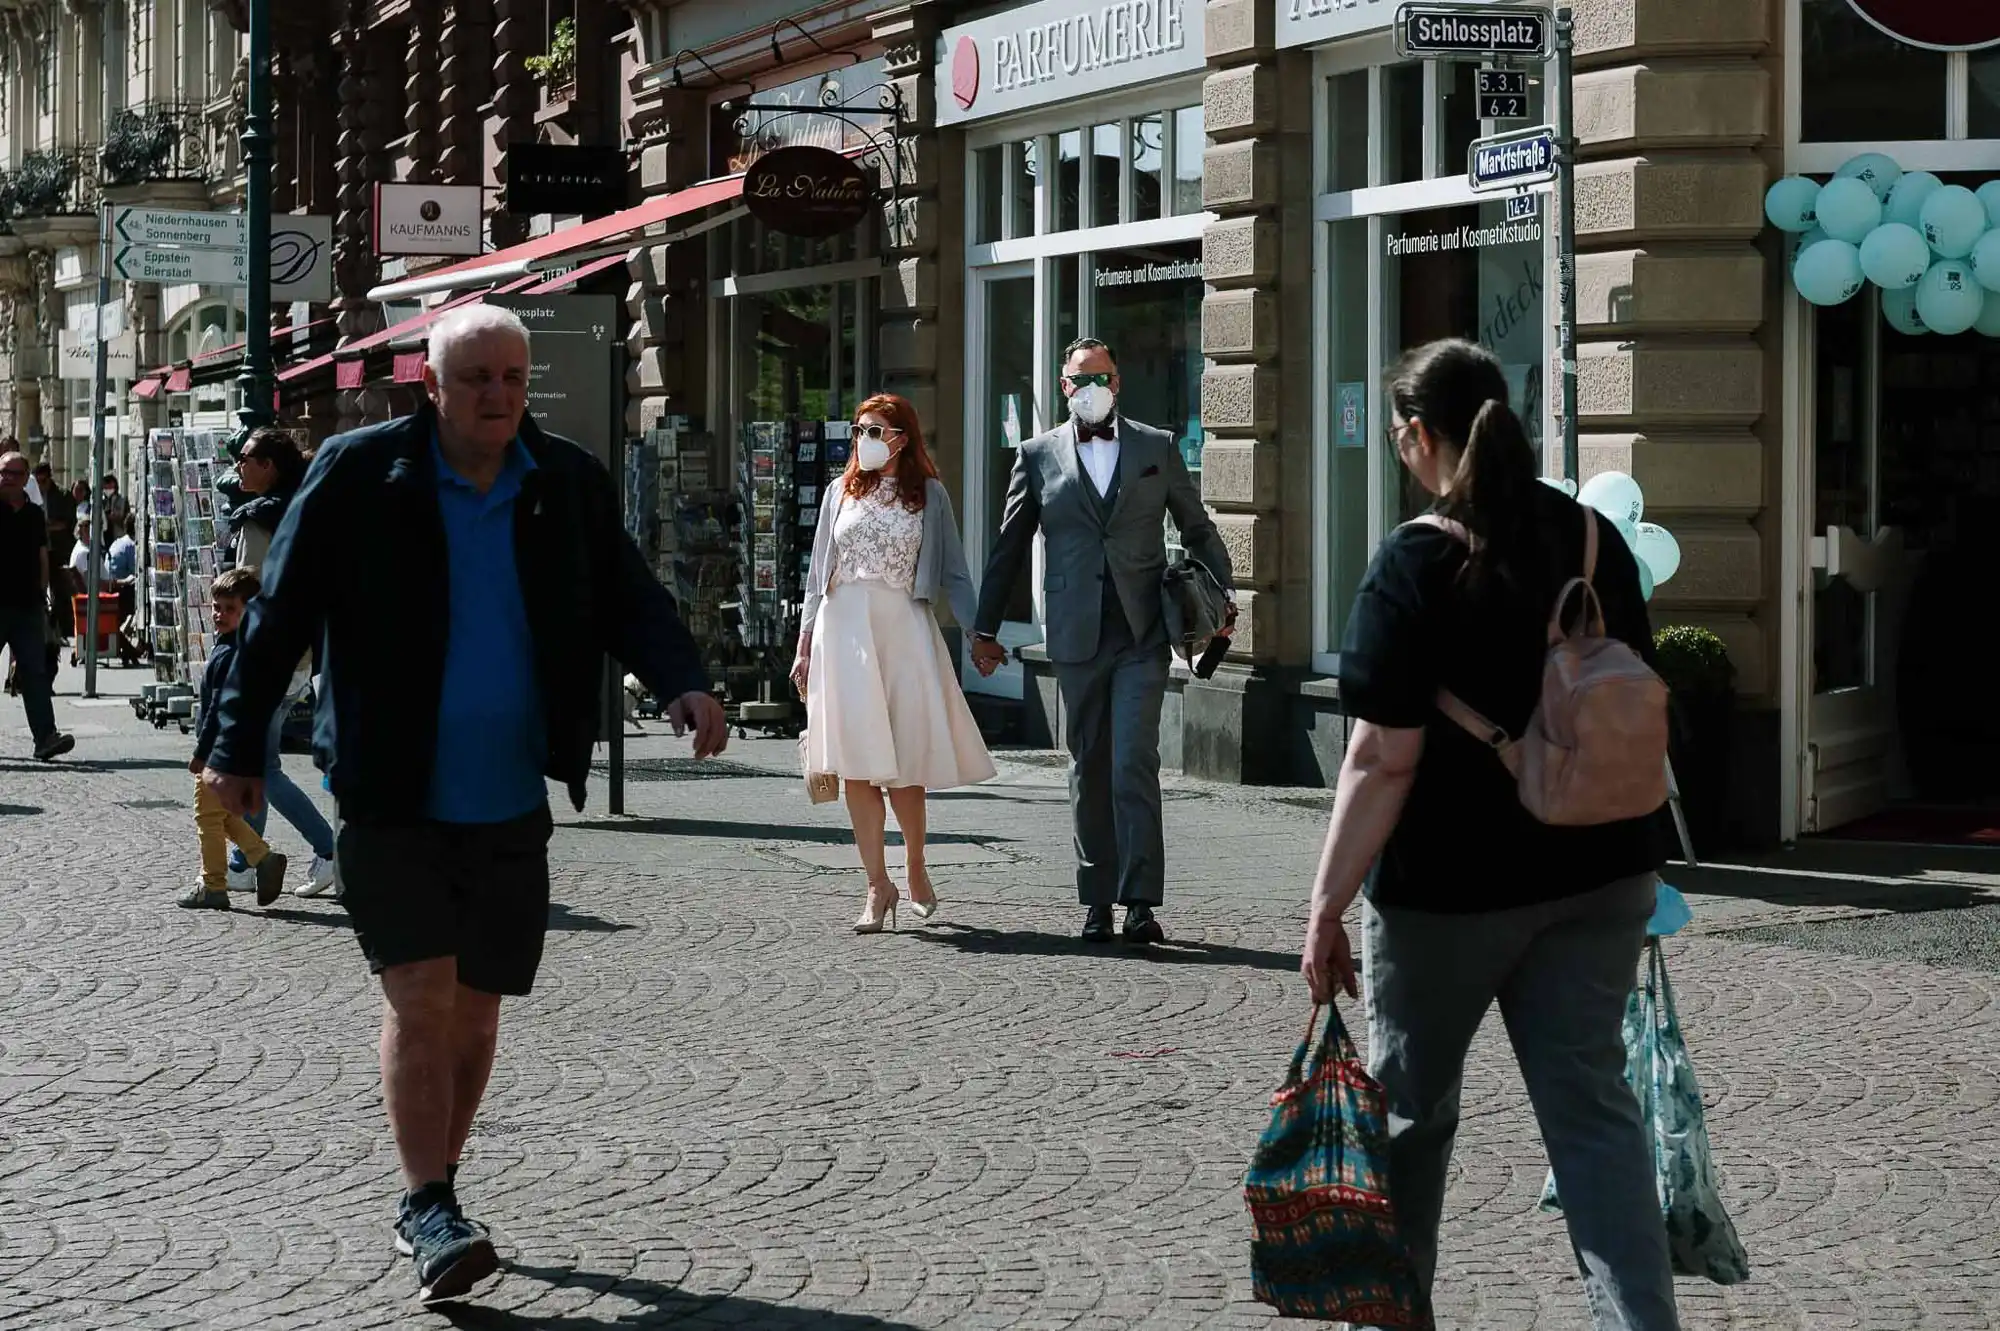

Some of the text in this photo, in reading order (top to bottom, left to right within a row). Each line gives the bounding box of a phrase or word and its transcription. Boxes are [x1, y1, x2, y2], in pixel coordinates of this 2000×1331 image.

[1418, 17, 1534, 49] Schlossplatz
[991, 0, 1185, 94] PARFUMERIE
[1480, 74, 1524, 92] 5.3.1
[1490, 98, 1518, 116] 6.2
[1478, 140, 1545, 176] Marktstraße
[748, 172, 863, 200] La Nature
[1509, 196, 1531, 217] 14-2
[145, 213, 246, 229] Niedernhausen 14
[390, 223, 471, 236] KAUFMANNS
[145, 228, 211, 243] Sonnenberg
[1387, 217, 1541, 256] Parfumerie und Kosmetikstudio
[144, 250, 244, 266] Eppstein 20
[143, 265, 192, 279] Bierstadt
[1095, 257, 1203, 288] Parfumerie und Kosmetikstudio
[527, 391, 567, 399] Information
